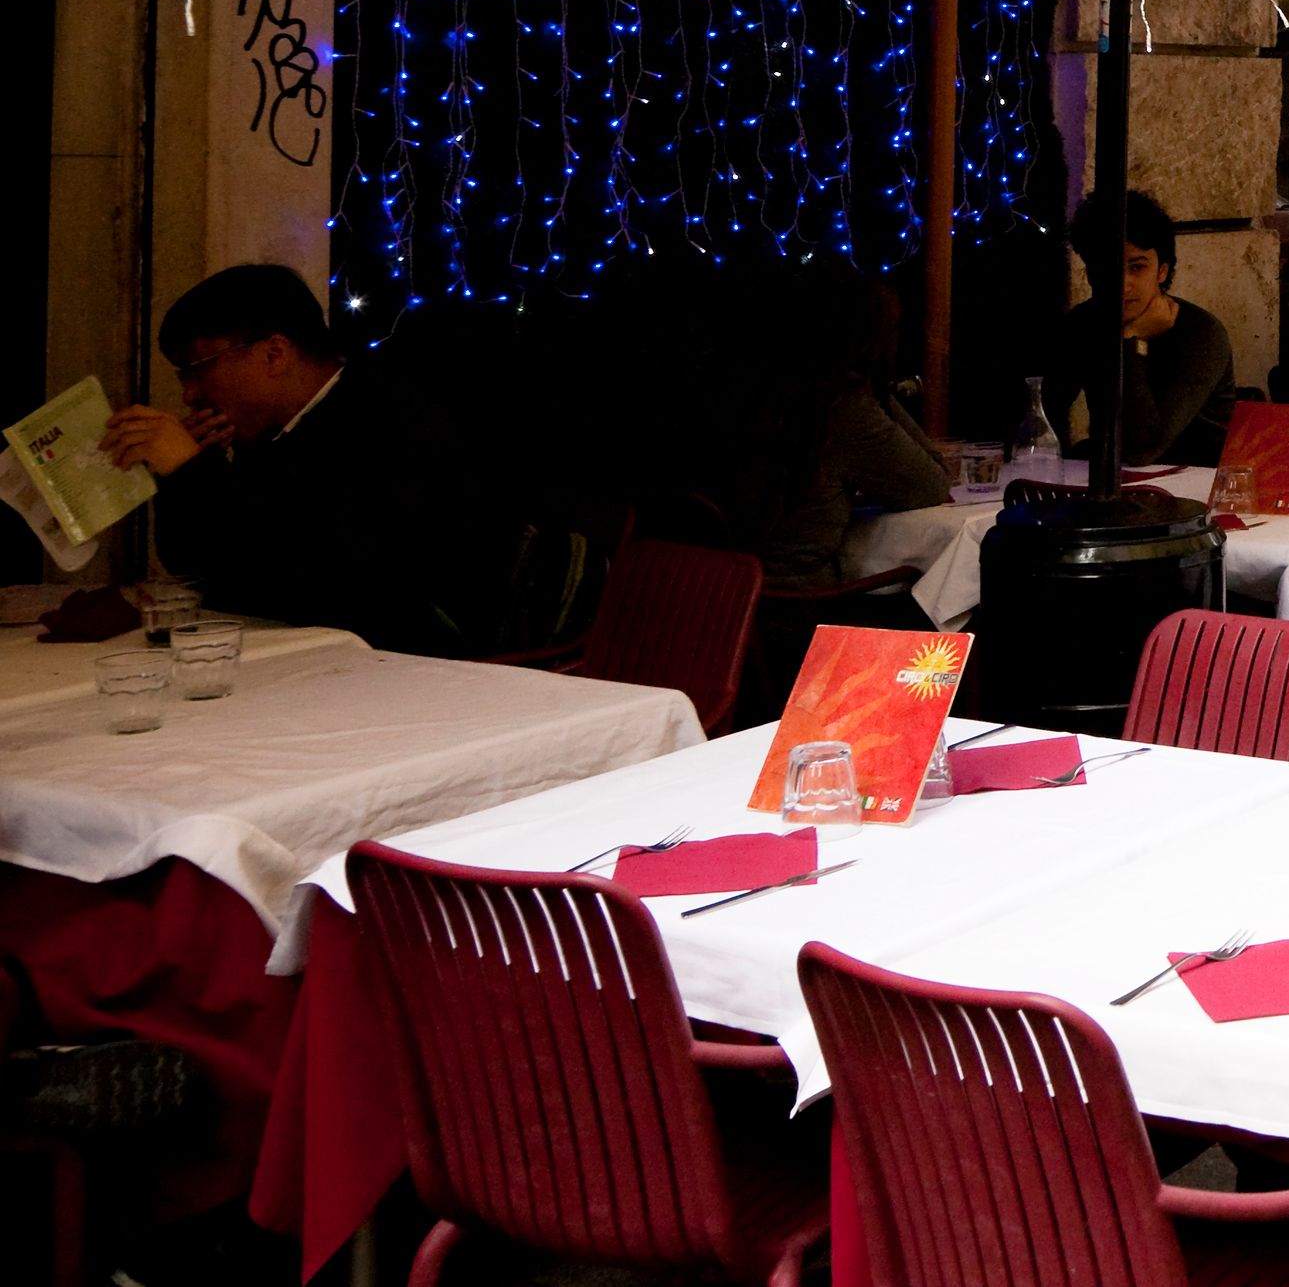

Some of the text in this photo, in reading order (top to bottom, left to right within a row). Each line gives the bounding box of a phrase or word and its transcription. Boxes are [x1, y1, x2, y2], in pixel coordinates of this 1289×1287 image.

[28, 426, 65, 455] ITALIA
[896, 669, 925, 684] CIRO
[931, 672, 960, 685] CIRO
